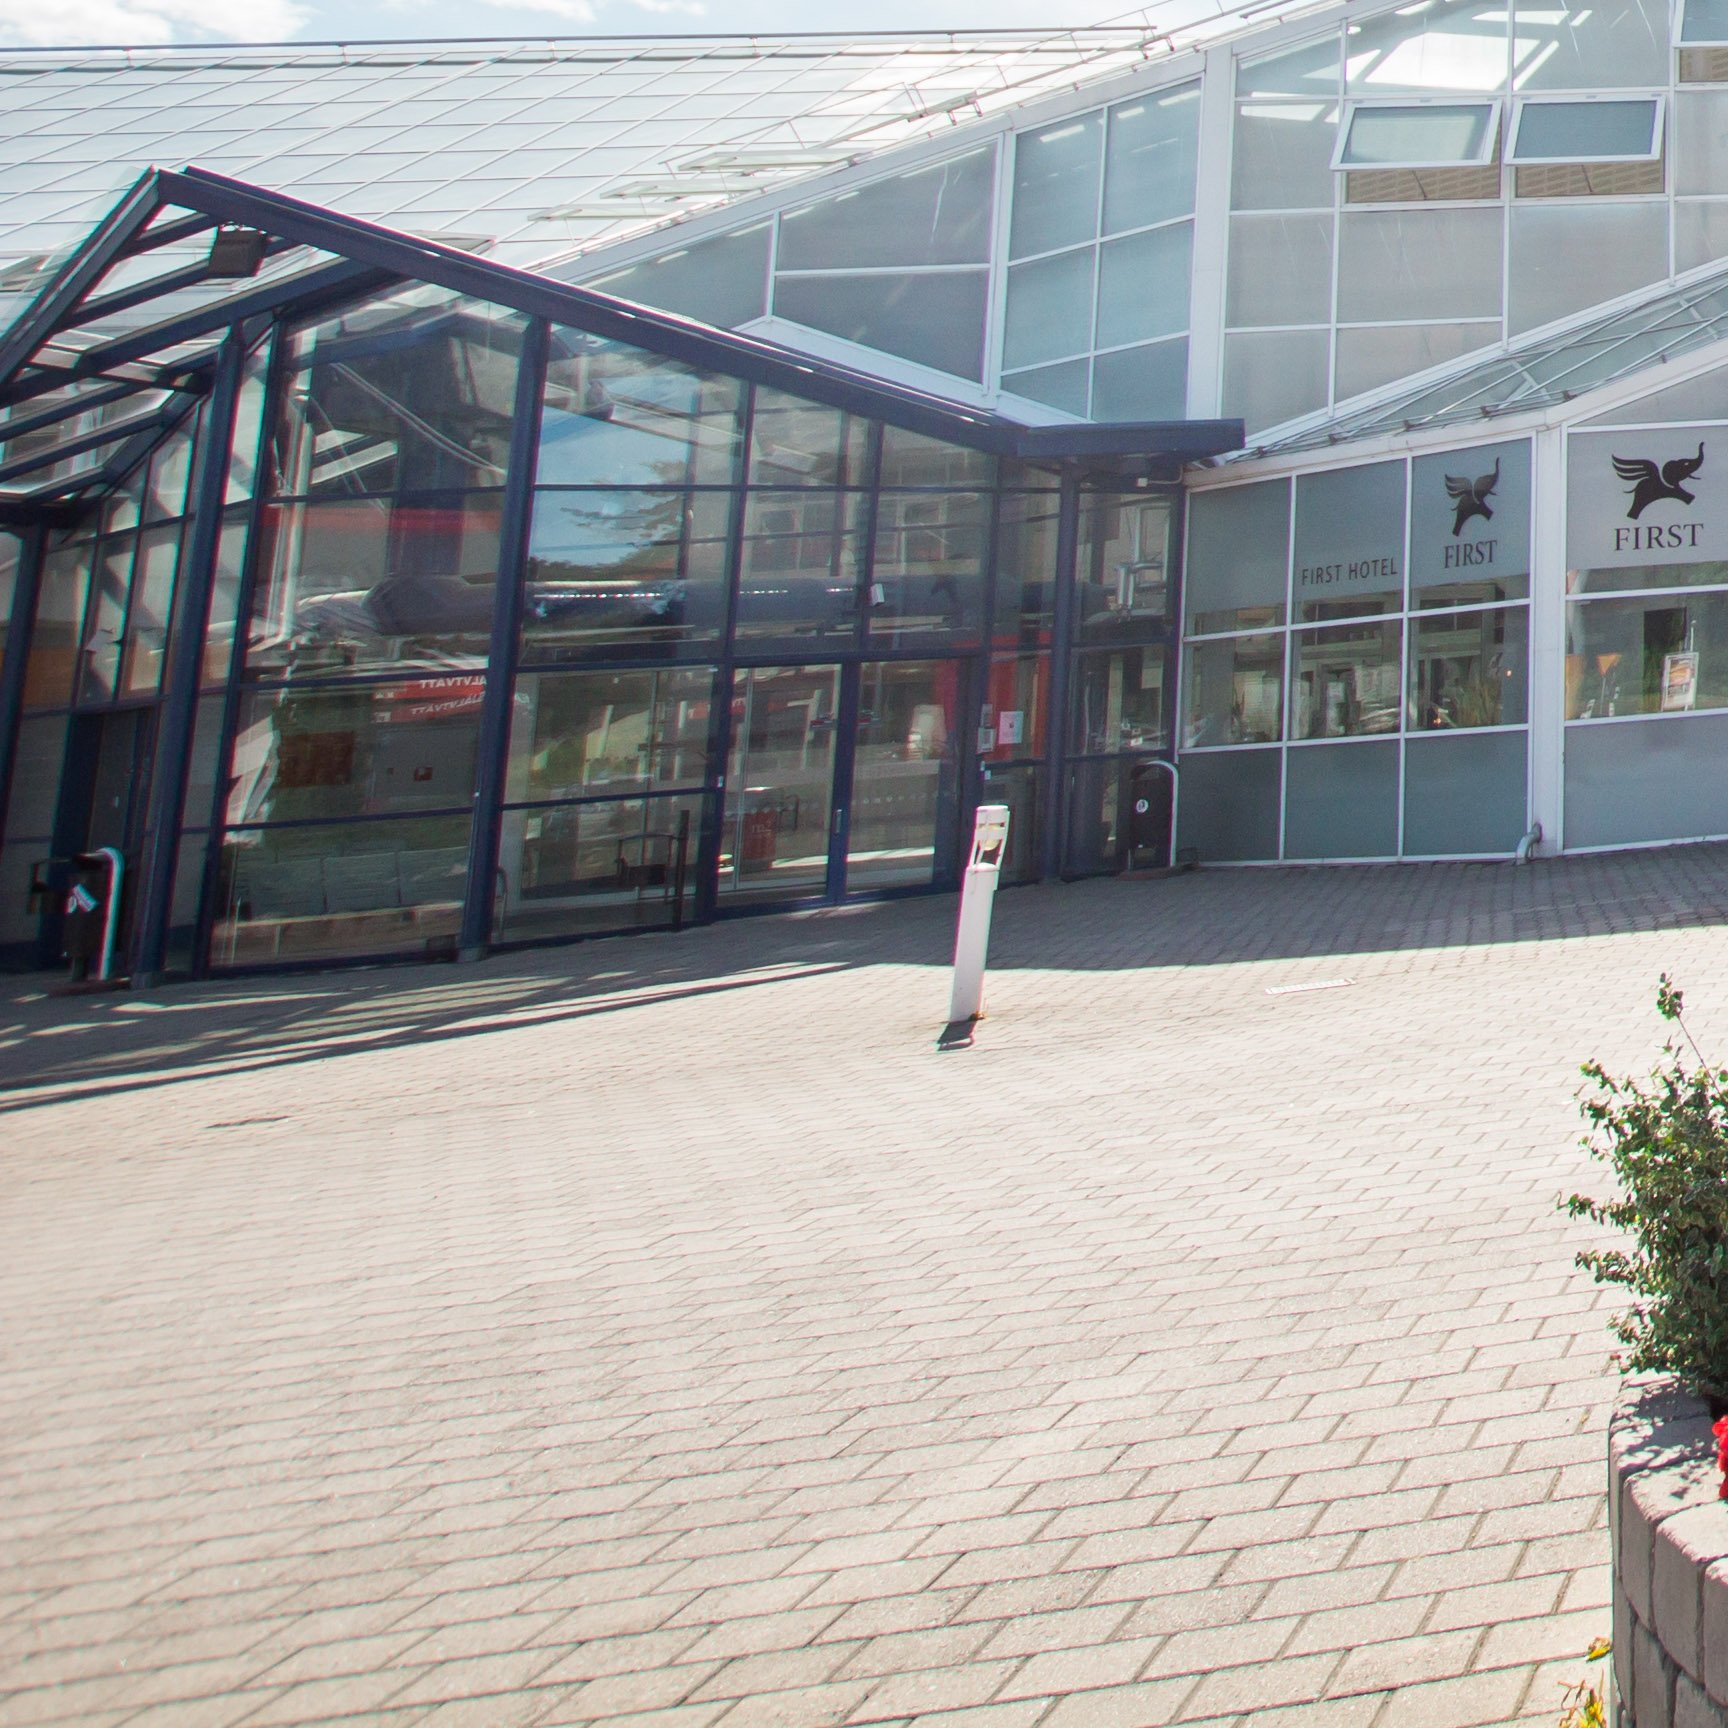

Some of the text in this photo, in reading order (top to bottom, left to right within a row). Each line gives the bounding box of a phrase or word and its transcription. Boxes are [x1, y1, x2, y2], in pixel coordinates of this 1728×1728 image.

[1613, 522, 1705, 551] FIRST
[1443, 539, 1498, 569] FIRST
[1301, 557, 1399, 586] FIRST HOTEL
